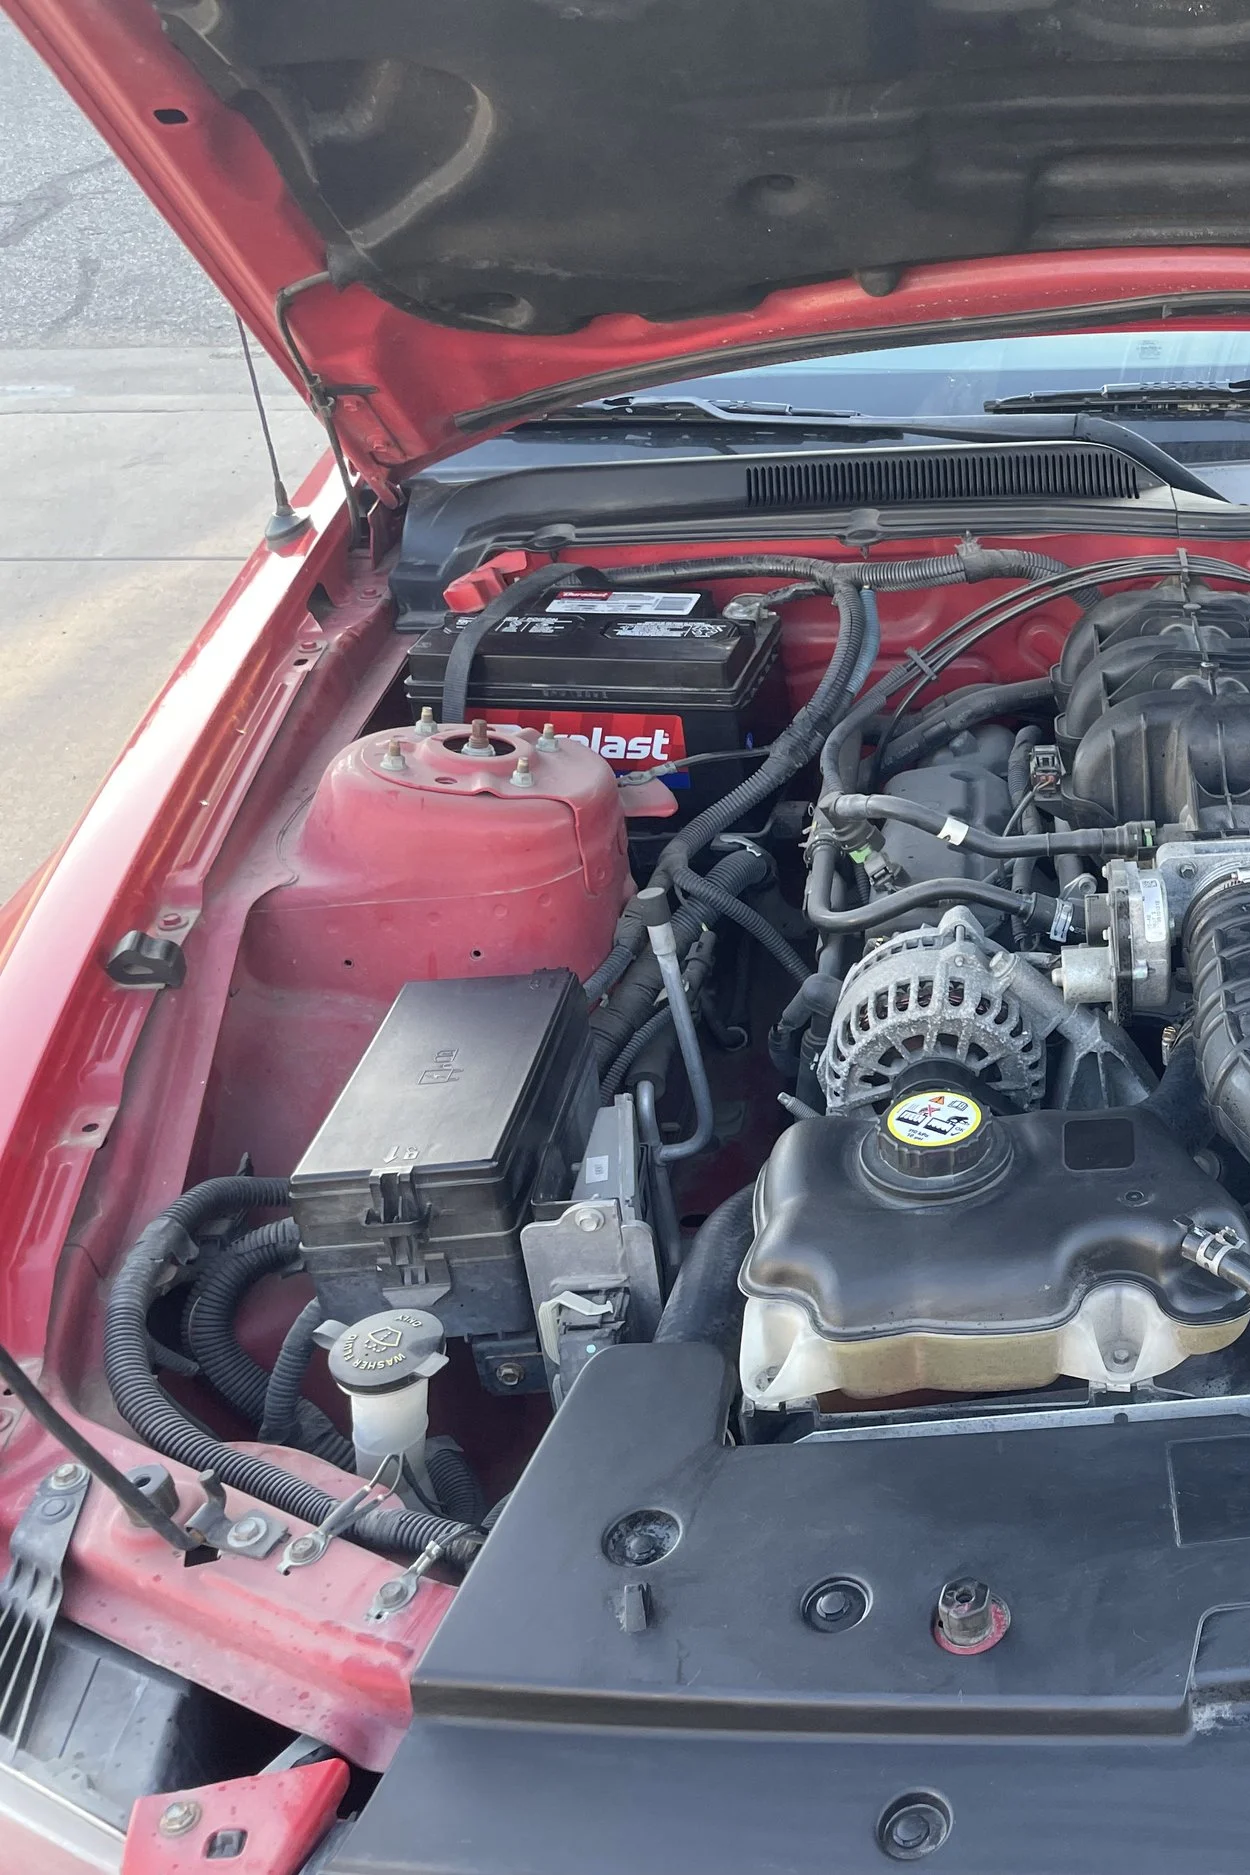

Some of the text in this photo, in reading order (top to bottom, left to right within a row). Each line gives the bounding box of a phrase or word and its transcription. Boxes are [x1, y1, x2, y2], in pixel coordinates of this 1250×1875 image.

[395, 1314, 422, 1327] ONLY
[343, 1334, 407, 1370] WASHER FLUID
